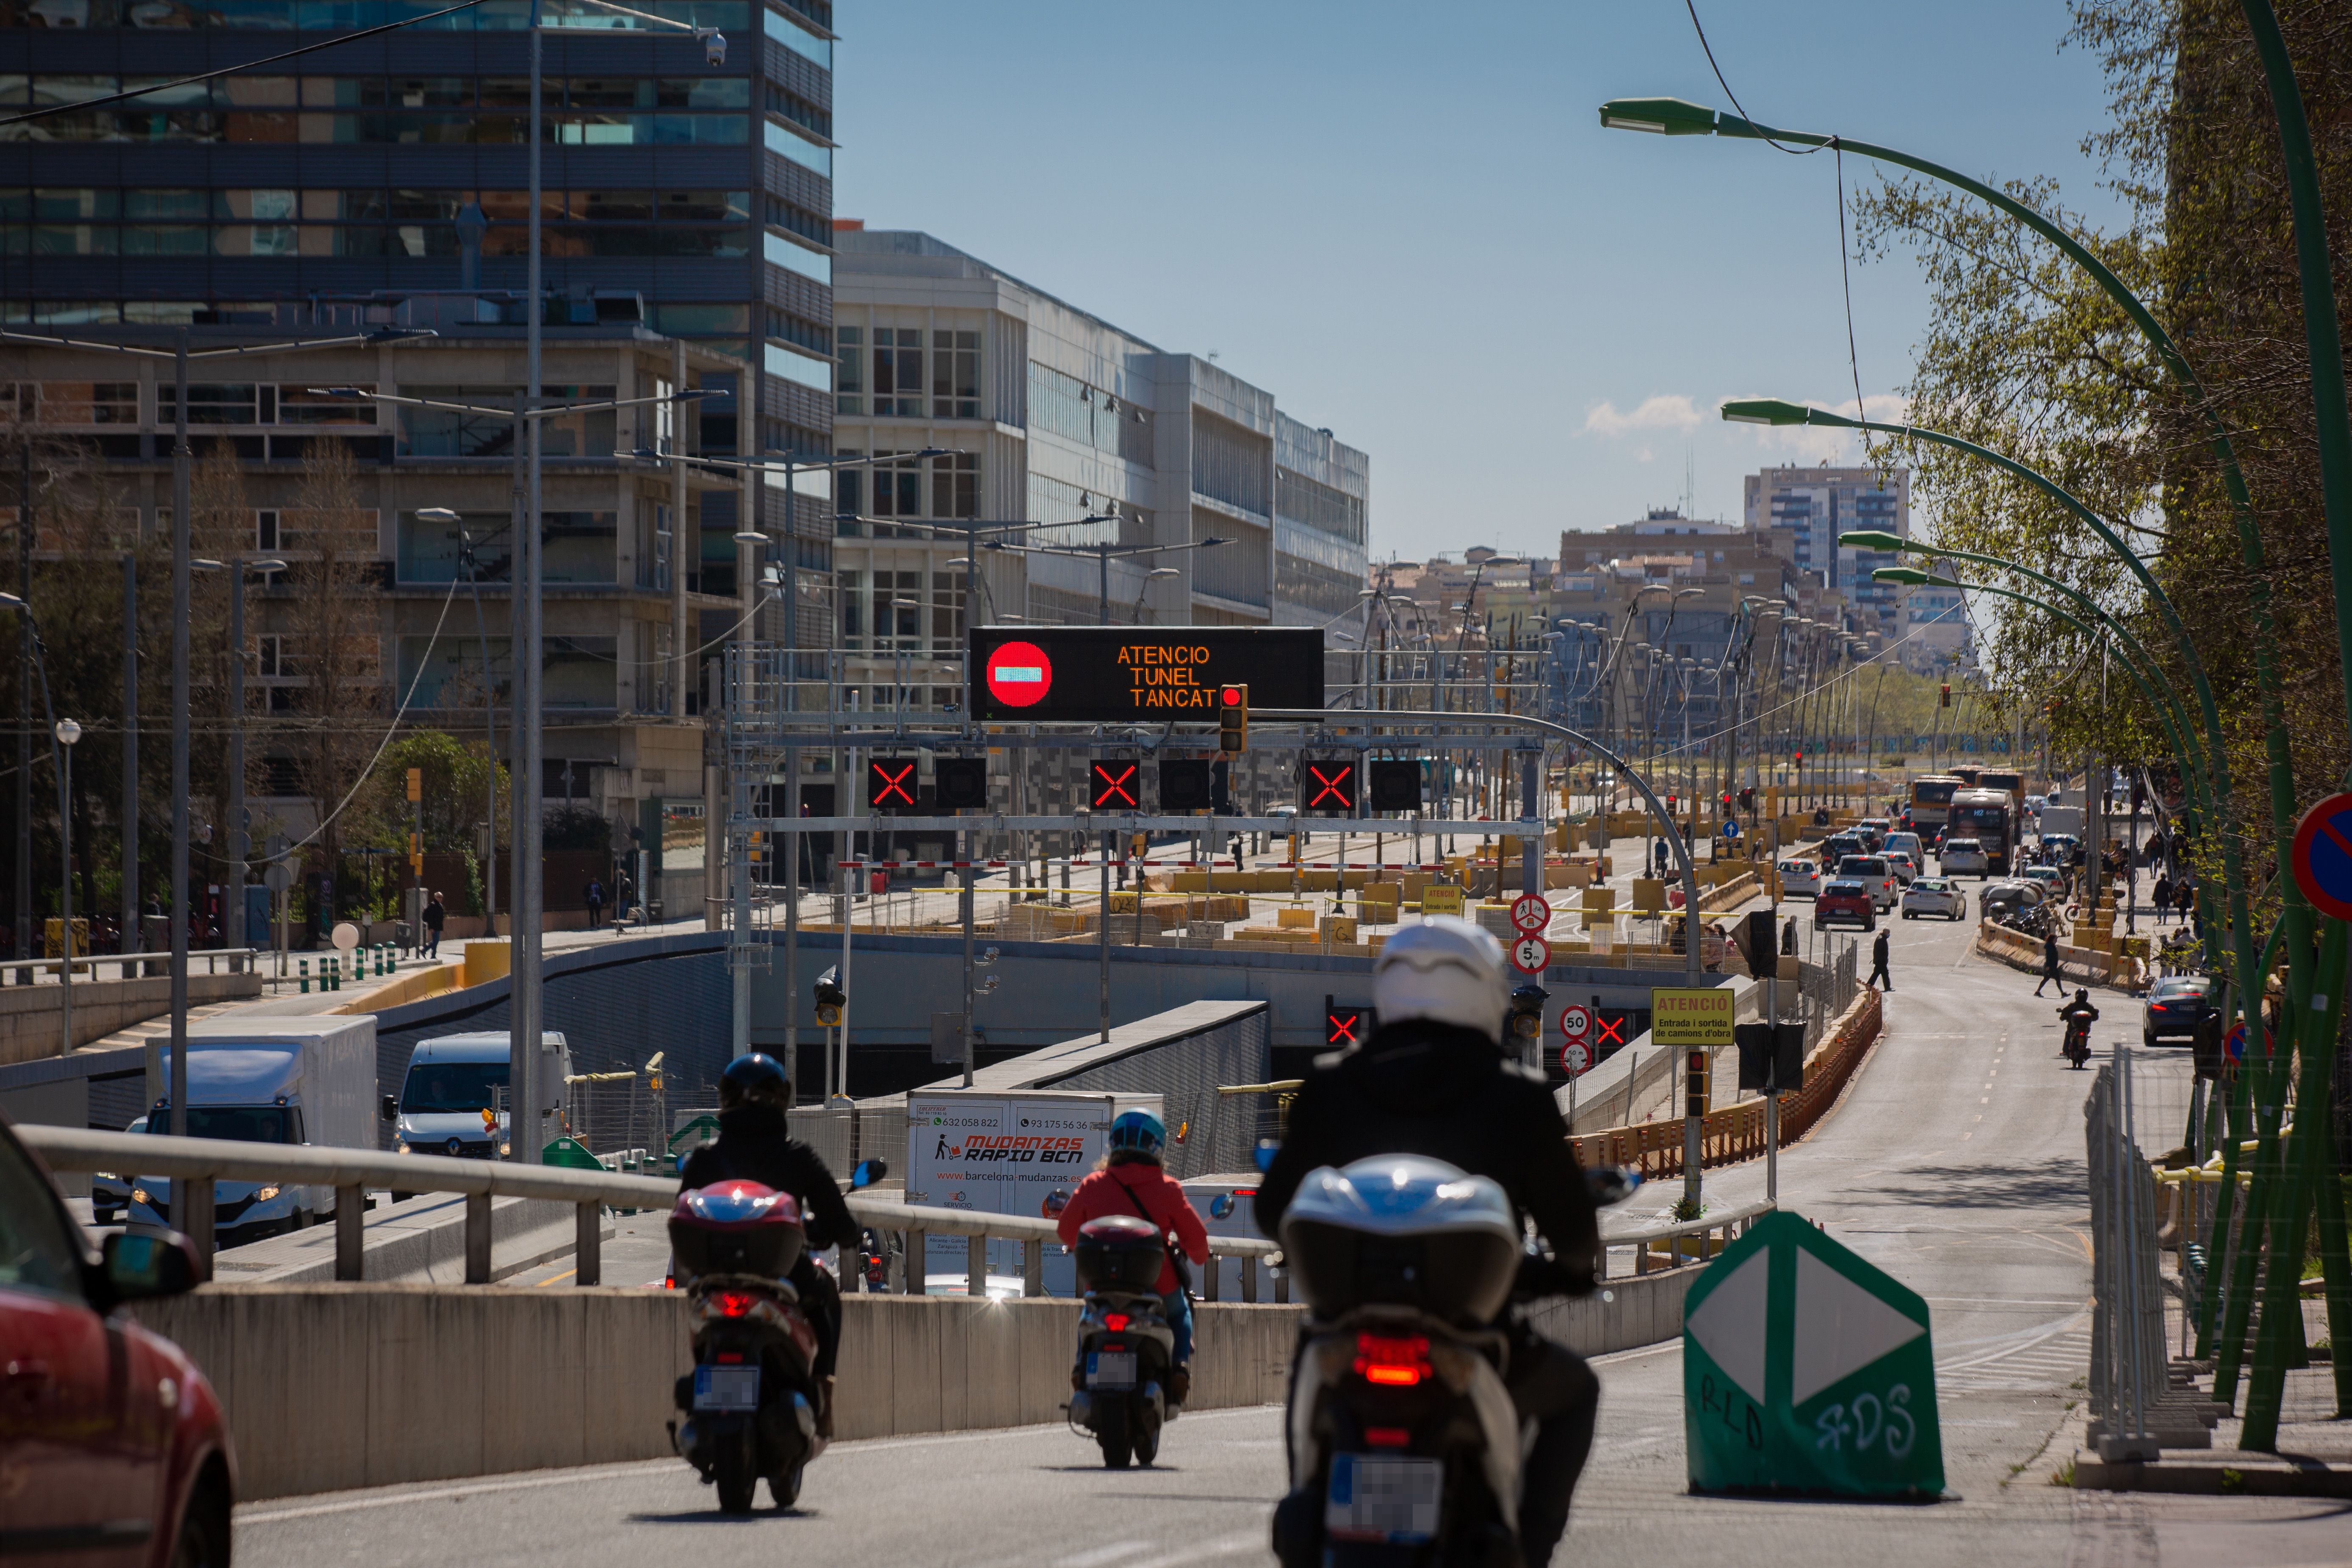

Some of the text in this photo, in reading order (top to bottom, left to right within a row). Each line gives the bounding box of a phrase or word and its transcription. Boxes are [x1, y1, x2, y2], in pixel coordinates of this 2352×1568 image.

[1118, 646, 1209, 664] ATENCIO
[1130, 667, 1200, 686] TUNEL
[1130, 689, 1216, 707] TANCAT
[1429, 889, 1454, 897] ATENCIÓ
[1657, 995, 1727, 1011] ATENCIÓ
[1567, 1017, 1584, 1028] 50
[1659, 1019, 1690, 1027] Entrada
[1699, 1019, 1727, 1027] sortida
[1668, 1029, 1702, 1037] camions
[943, 1118, 959, 1126] 632
[962, 1118, 979, 1126] 058
[1031, 1120, 1087, 1129] 93 175 56 36
[964, 1135, 1084, 1150] MUDANZAS
[964, 1149, 1083, 1163] RAPID BCN
[937, 1171, 1081, 1183] www.barcelona-mudanzas.es
